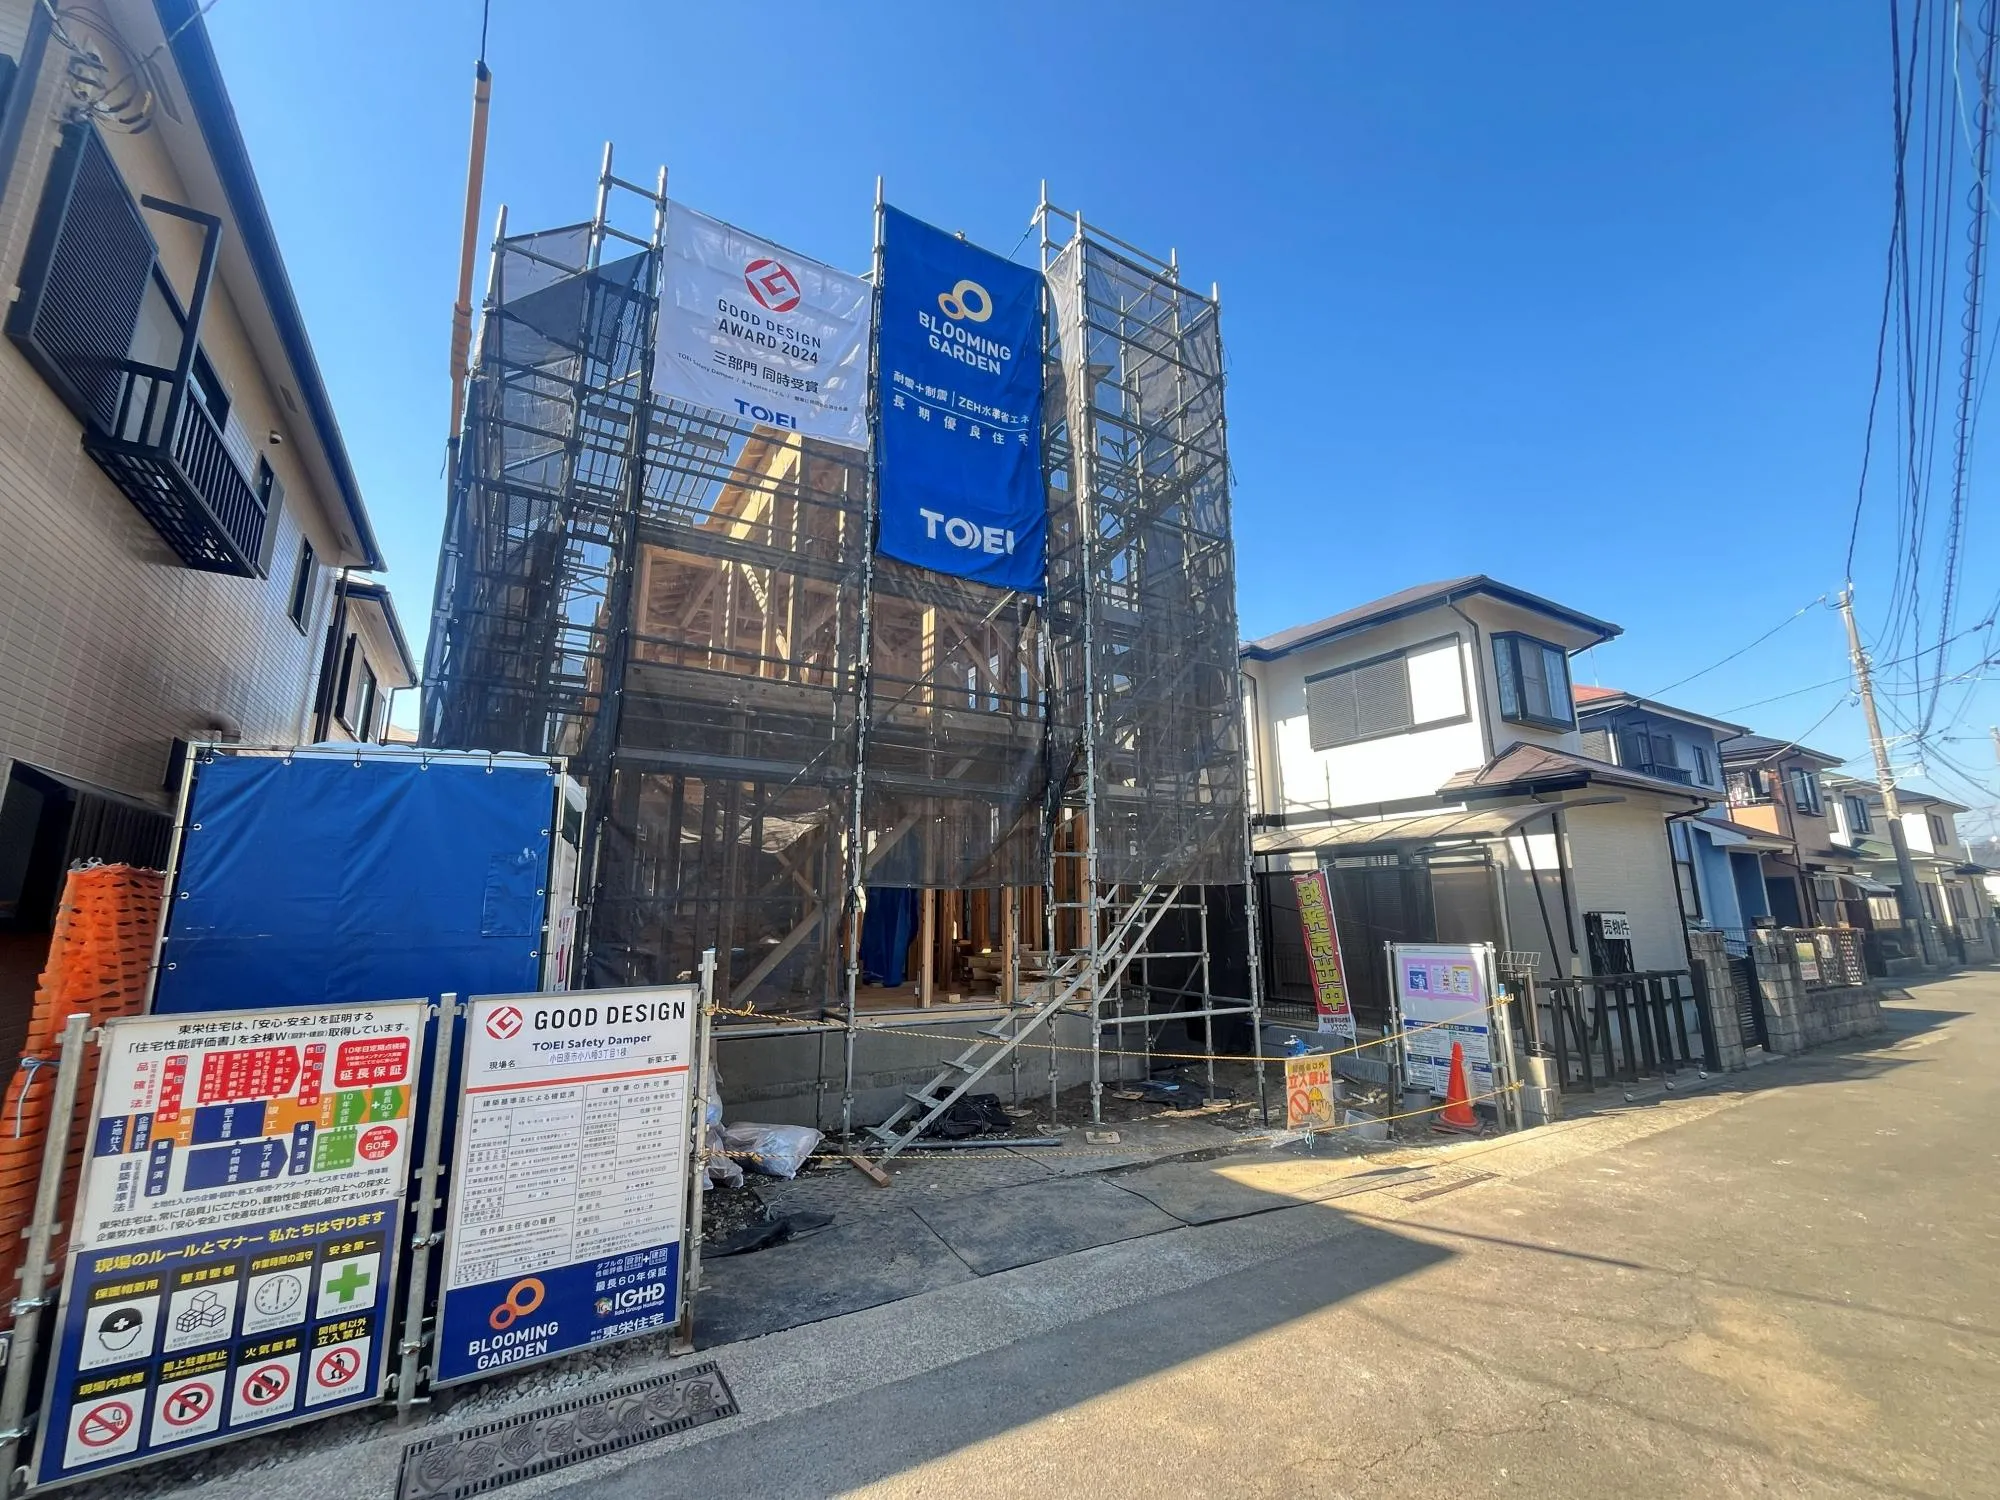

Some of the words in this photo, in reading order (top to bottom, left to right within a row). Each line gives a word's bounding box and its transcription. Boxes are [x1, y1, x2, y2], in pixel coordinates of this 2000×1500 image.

[718, 297, 761, 328] GOOD
[766, 318, 822, 349] DESIGN
[918, 309, 1012, 361] BLOOMING
[718, 318, 777, 352] AWARD
[781, 340, 819, 365] 2024
[928, 333, 1002, 376] GARDEN
[713, 349, 758, 378] 三部門
[762, 365, 819, 394] 同時受賞
[733, 398, 797, 430] TOEI
[919, 507, 1016, 556] TOEI
[1603, 919, 1630, 936] 売物件
[533, 1006, 598, 1030] GOOD
[606, 1001, 685, 1024] DESIGN
[532, 1040, 564, 1051] TOEI
[567, 1037, 604, 1050] Safety
[607, 1033, 651, 1047] Damper
[339, 1064, 403, 1081] 延長保証
[488, 1059, 516, 1070] 現場名
[647, 1054, 677, 1064] 新築工事
[1288, 1071, 1330, 1089] 立入禁止
[340, 1093, 353, 1123] 10年保証
[482, 1090, 575, 1107] 建築基準法による確認済
[108, 1118, 124, 1152] 土地仕入
[364, 1140, 391, 1151] 60年
[93, 1232, 264, 1274] 現場のルールとマナー
[267, 1209, 385, 1244] 私たちは守ります
[328, 1238, 376, 1256] 安全第一
[180, 1264, 235, 1284] 整理整頓
[595, 1265, 667, 1292] 最長60年保証
[614, 1281, 665, 1310] IGHD
[317, 1326, 365, 1345] 立入禁止
[318, 1316, 366, 1335] 関係者以外
[468, 1320, 559, 1356] BLOOMING
[602, 1312, 663, 1339] 東栄住宅
[244, 1337, 297, 1359] 火気厳禁
[476, 1339, 547, 1370] GARDEN
